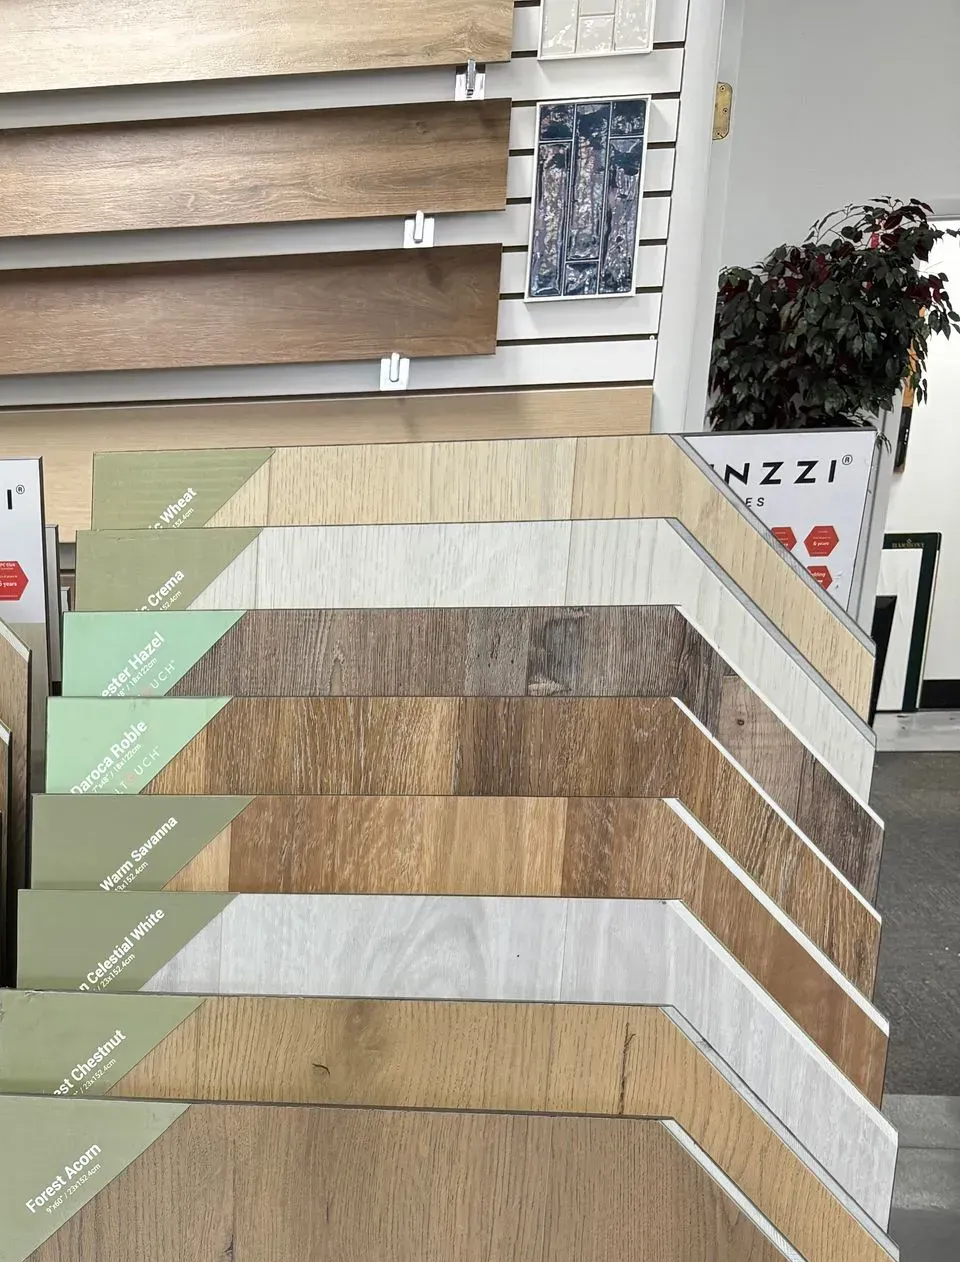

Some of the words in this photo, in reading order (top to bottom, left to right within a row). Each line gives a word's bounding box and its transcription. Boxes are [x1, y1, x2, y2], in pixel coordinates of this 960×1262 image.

[159, 487, 197, 524] Wheat
[3, 580, 17, 588] years
[147, 570, 185, 607] Crema
[127, 631, 165, 670] Hazel
[110, 721, 148, 758] Roble
[99, 860, 134, 891] Warm
[131, 816, 178, 862] Savanna
[86, 936, 134, 984] Celestial
[129, 909, 165, 941] White
[100, 953, 136, 988] 23x152.4cm
[71, 1029, 126, 1082] Chestnut
[82, 1058, 117, 1090] 23x152.4cm
[25, 1175, 67, 1214] Forest
[64, 1144, 102, 1180] Acorn
[67, 1163, 101, 1195] 23x152.4cm
